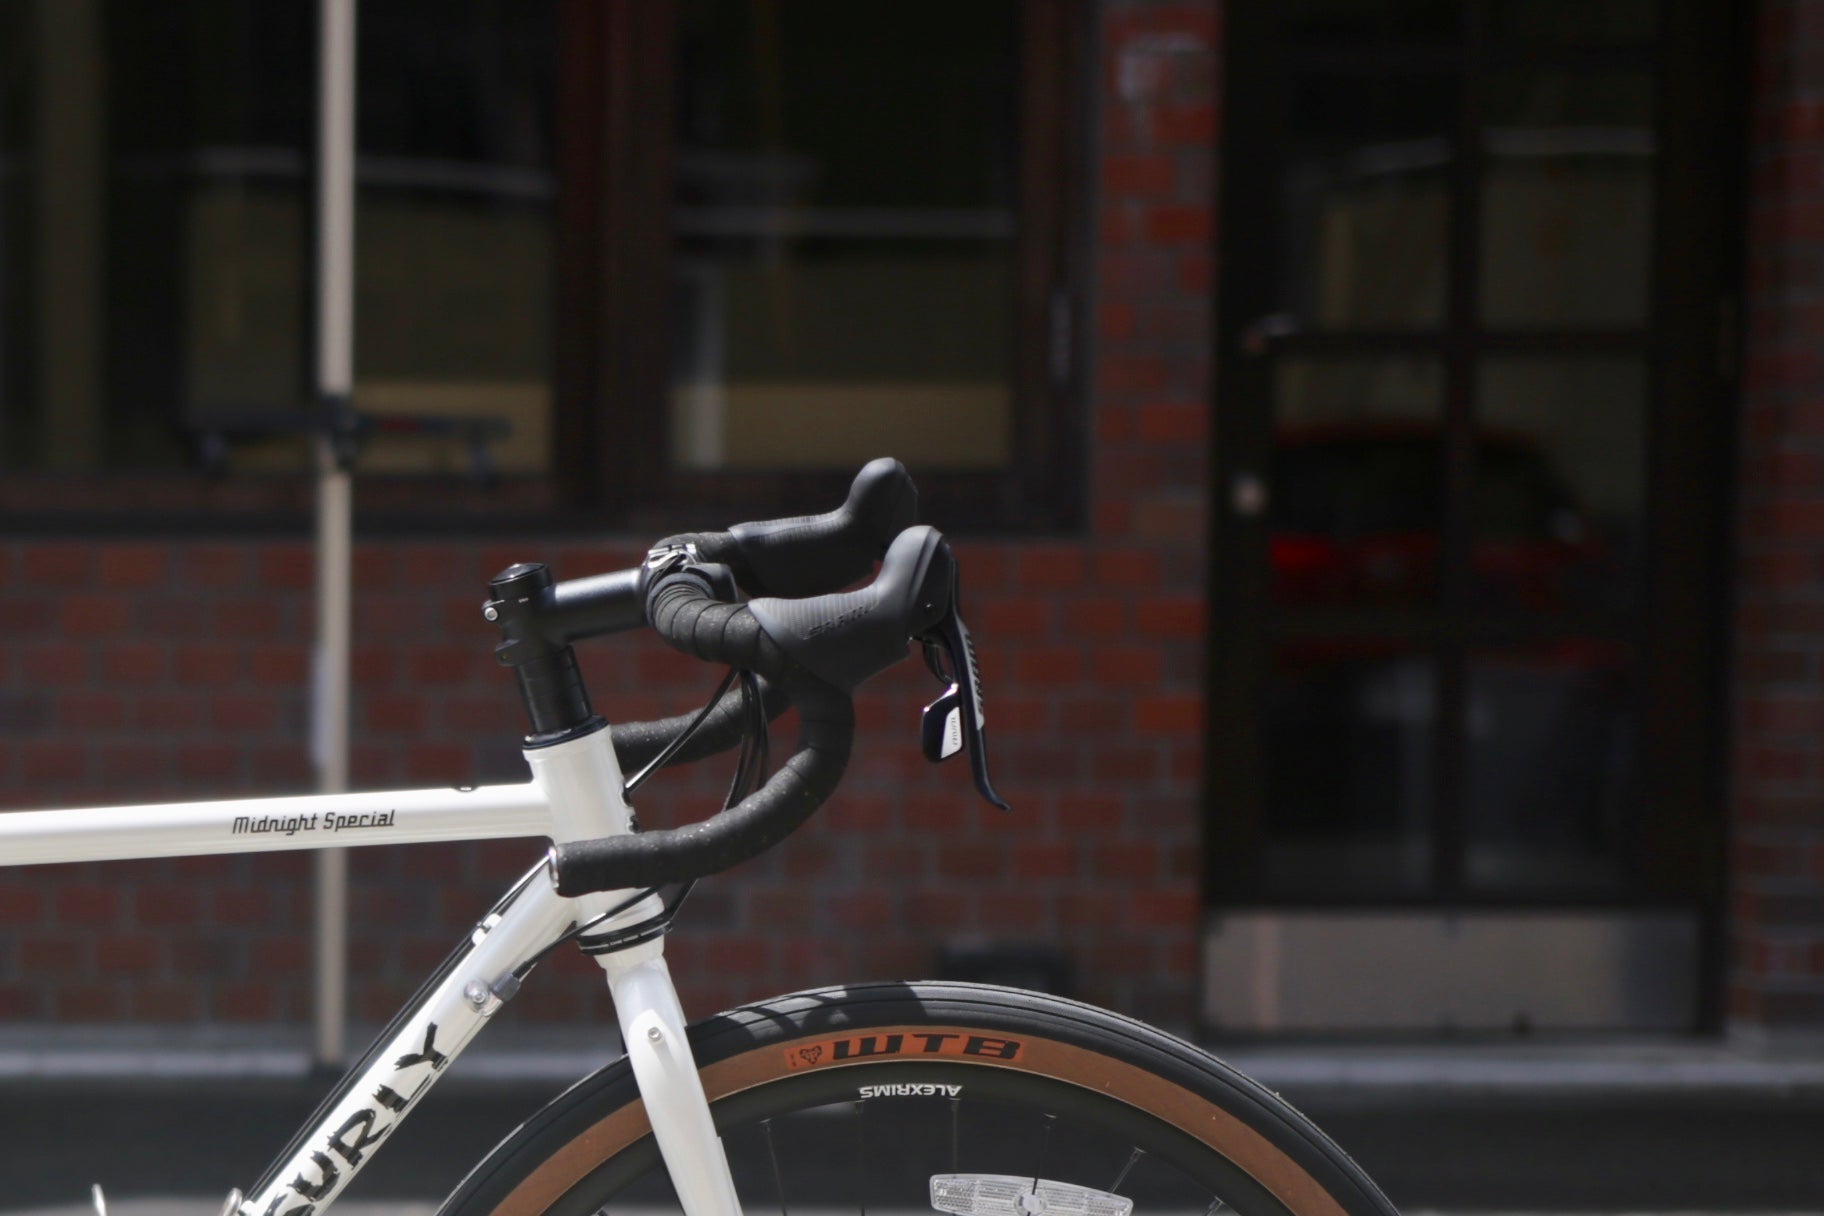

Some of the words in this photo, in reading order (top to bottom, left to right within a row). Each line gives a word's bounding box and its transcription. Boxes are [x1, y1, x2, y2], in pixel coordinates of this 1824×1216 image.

[232, 813, 319, 836] Midnight
[323, 809, 396, 832] Special
[832, 1033, 1022, 1061] WTB
[858, 1083, 963, 1099] ALEXRIMS
